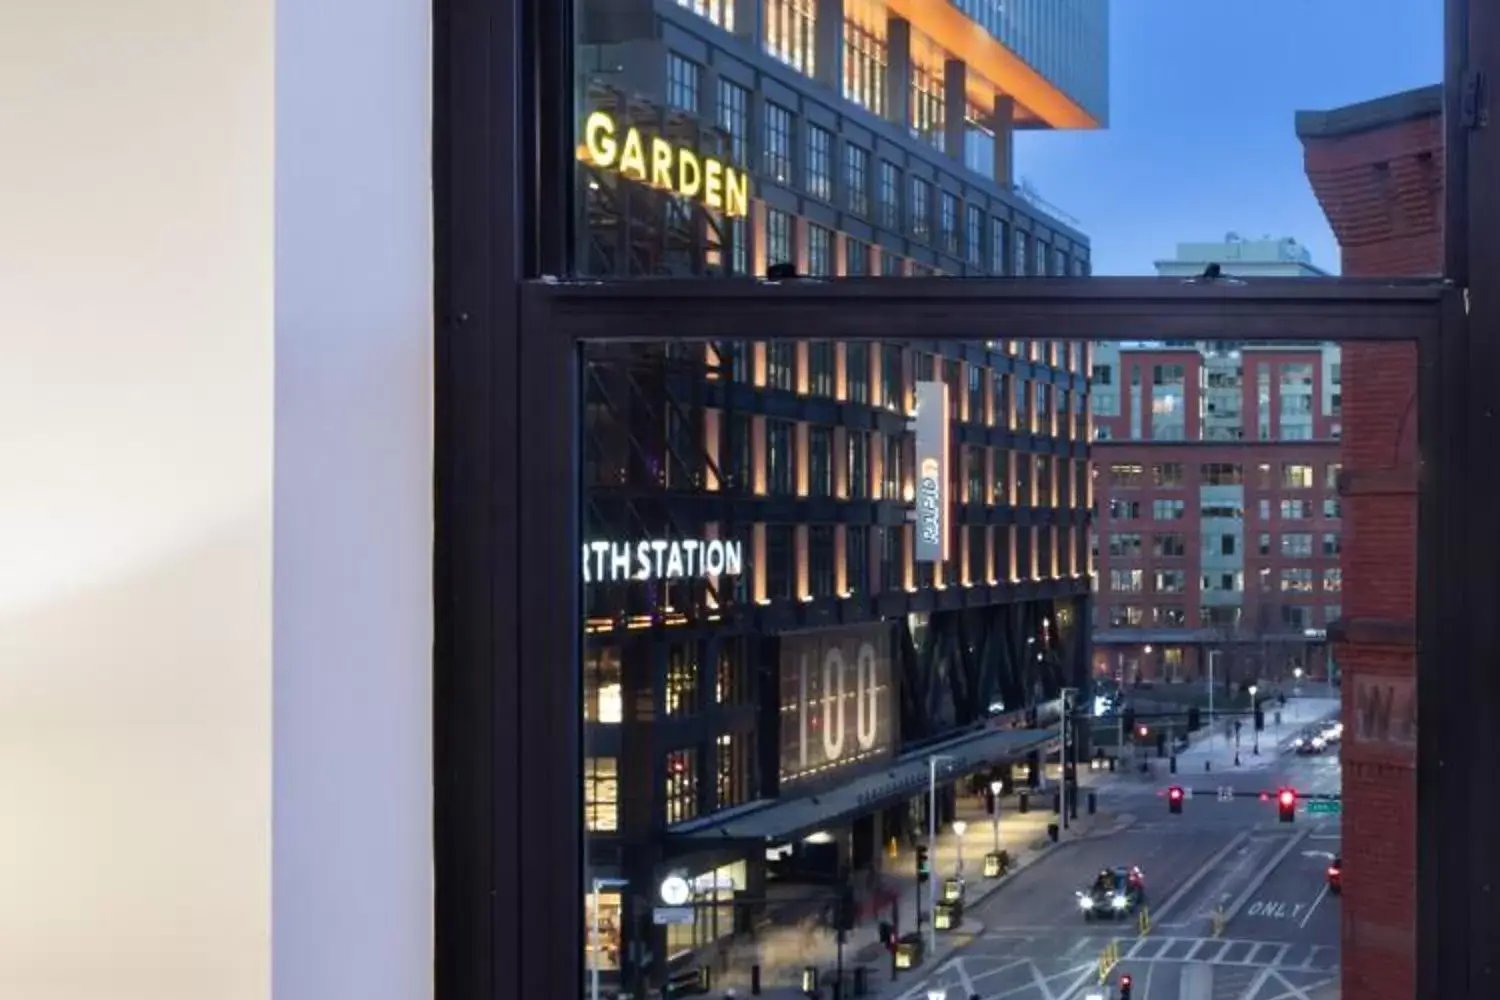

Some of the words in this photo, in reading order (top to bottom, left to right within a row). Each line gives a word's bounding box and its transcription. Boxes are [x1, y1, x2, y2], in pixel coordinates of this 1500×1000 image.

[587, 111, 748, 217] GARDEN
[633, 540, 741, 580] STATION
[800, 643, 877, 766] 100
